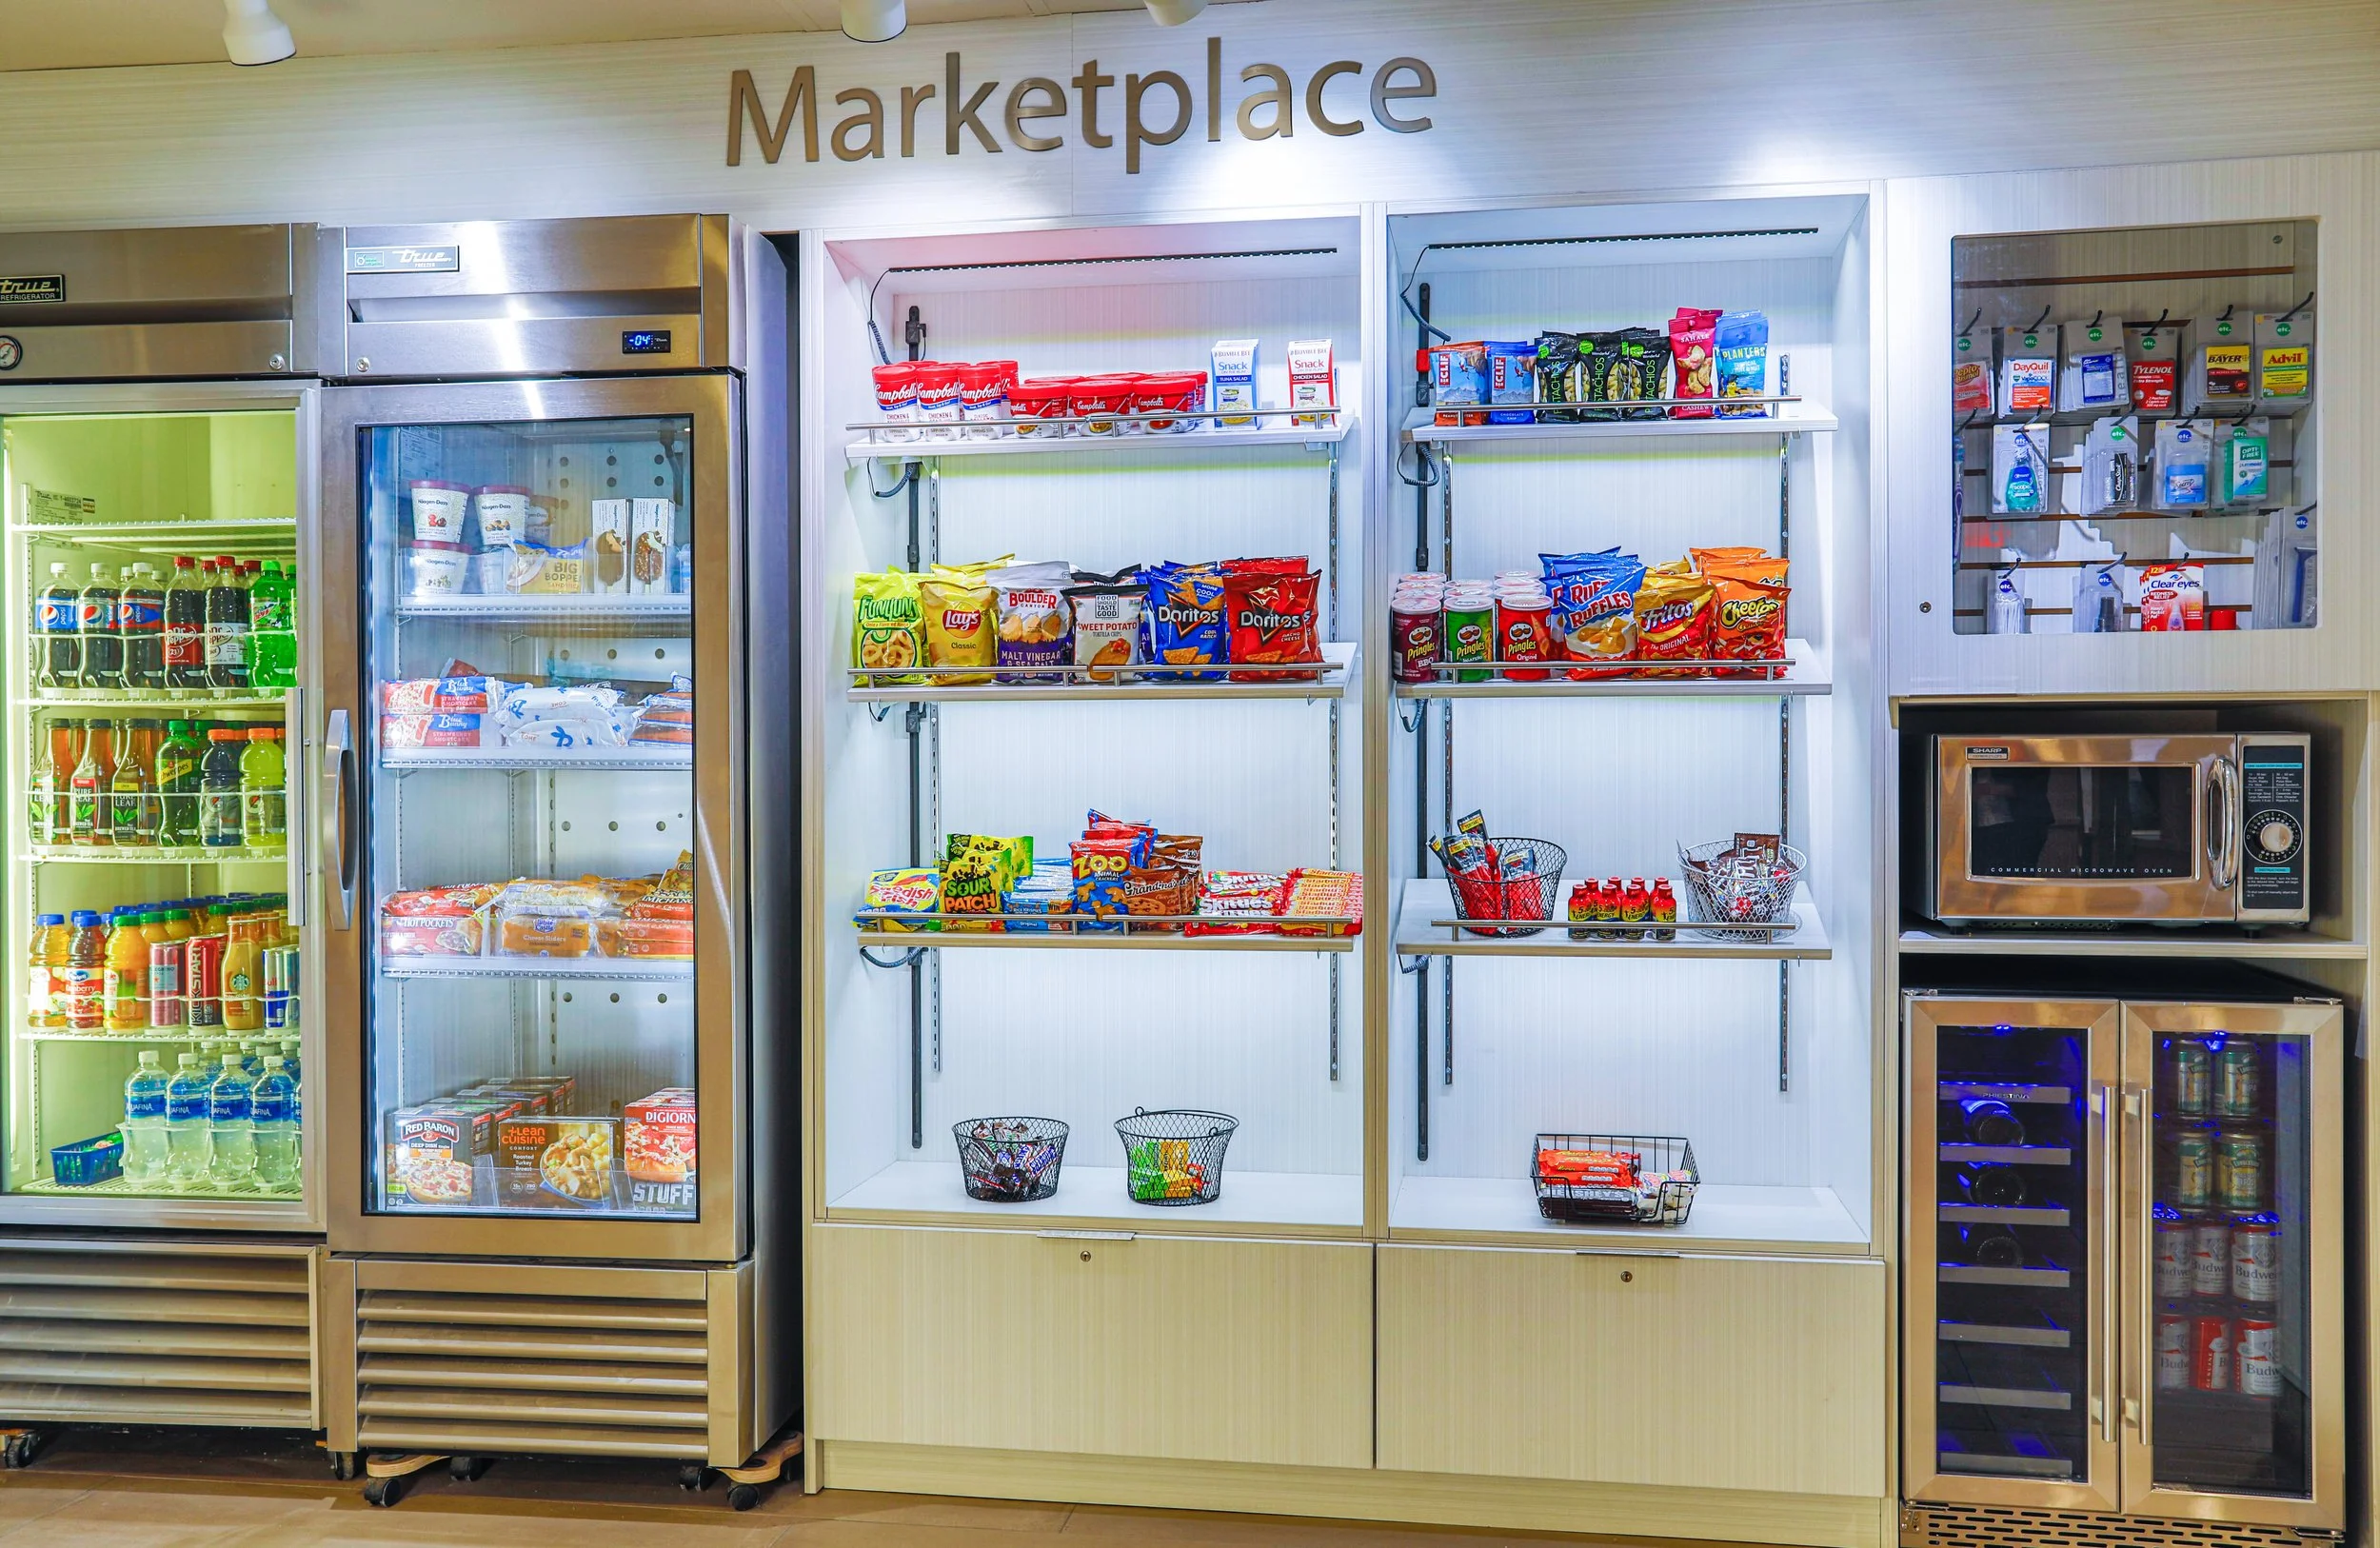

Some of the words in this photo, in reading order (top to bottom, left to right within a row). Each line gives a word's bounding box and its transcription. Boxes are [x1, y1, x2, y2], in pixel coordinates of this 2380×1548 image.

[726, 36, 1437, 175] Marketplace
[1680, 333, 1710, 343] SAHALE
[1722, 347, 1765, 360] PLANTERS
[2208, 355, 2242, 364] BAYER
[2268, 353, 2301, 364] Advil
[1219, 362, 1247, 370] Snack
[1295, 359, 1324, 368] Snack
[2013, 363, 2049, 373] DayQuil
[2133, 366, 2172, 375] TYLENOL
[876, 383, 917, 403] Campbell
[918, 382, 959, 403] Campbell
[1077, 401, 1106, 410] Campbell's
[1138, 397, 1163, 407] Campbell's
[554, 562, 578, 574] BIG
[1196, 588, 1215, 597] COOL
[2151, 580, 2176, 588] Clear
[2177, 581, 2200, 590] eyes
[1009, 592, 1058, 609] BOULDER
[859, 595, 921, 623] FUNYUNS
[1158, 605, 1220, 623] Doritos
[1569, 591, 1632, 629] RUFFLES
[1640, 602, 1694, 632] Fritos
[1721, 598, 1780, 627] Cheetos
[945, 610, 980, 630] Lay's
[1078, 623, 1104, 631] SWEET
[1105, 622, 1138, 630] POTATO
[1240, 611, 1300, 628] Doritos
[1457, 640, 1485, 660] Pringles
[1508, 639, 1537, 657] Pringles
[1659, 633, 1691, 651] ORIGINAL
[1002, 651, 1022, 660] MALT
[1026, 650, 1061, 662] VINEGAR
[1407, 642, 1436, 662] Pringles
[1418, 656, 1434, 667] BBQ
[162, 762, 188, 780] chweppes
[1073, 854, 1127, 880] ZOO
[946, 878, 991, 896] SOUR
[1123, 879, 1177, 897] Grandma's
[944, 894, 997, 912] PATCH
[1048, 903, 1061, 911] WIN
[1200, 897, 1273, 911] Skittles
[403, 920, 420, 928] HOT
[420, 920, 454, 928] POCKETS
[190, 946, 202, 1025] KICKSTART
[645, 1111, 695, 1124] DIGIORN
[405, 1123, 423, 1135] RED
[423, 1121, 455, 1136] BARON
[633, 1183, 693, 1205] STUFF
[1546, 1190, 1624, 1199] HERSHEY'S
